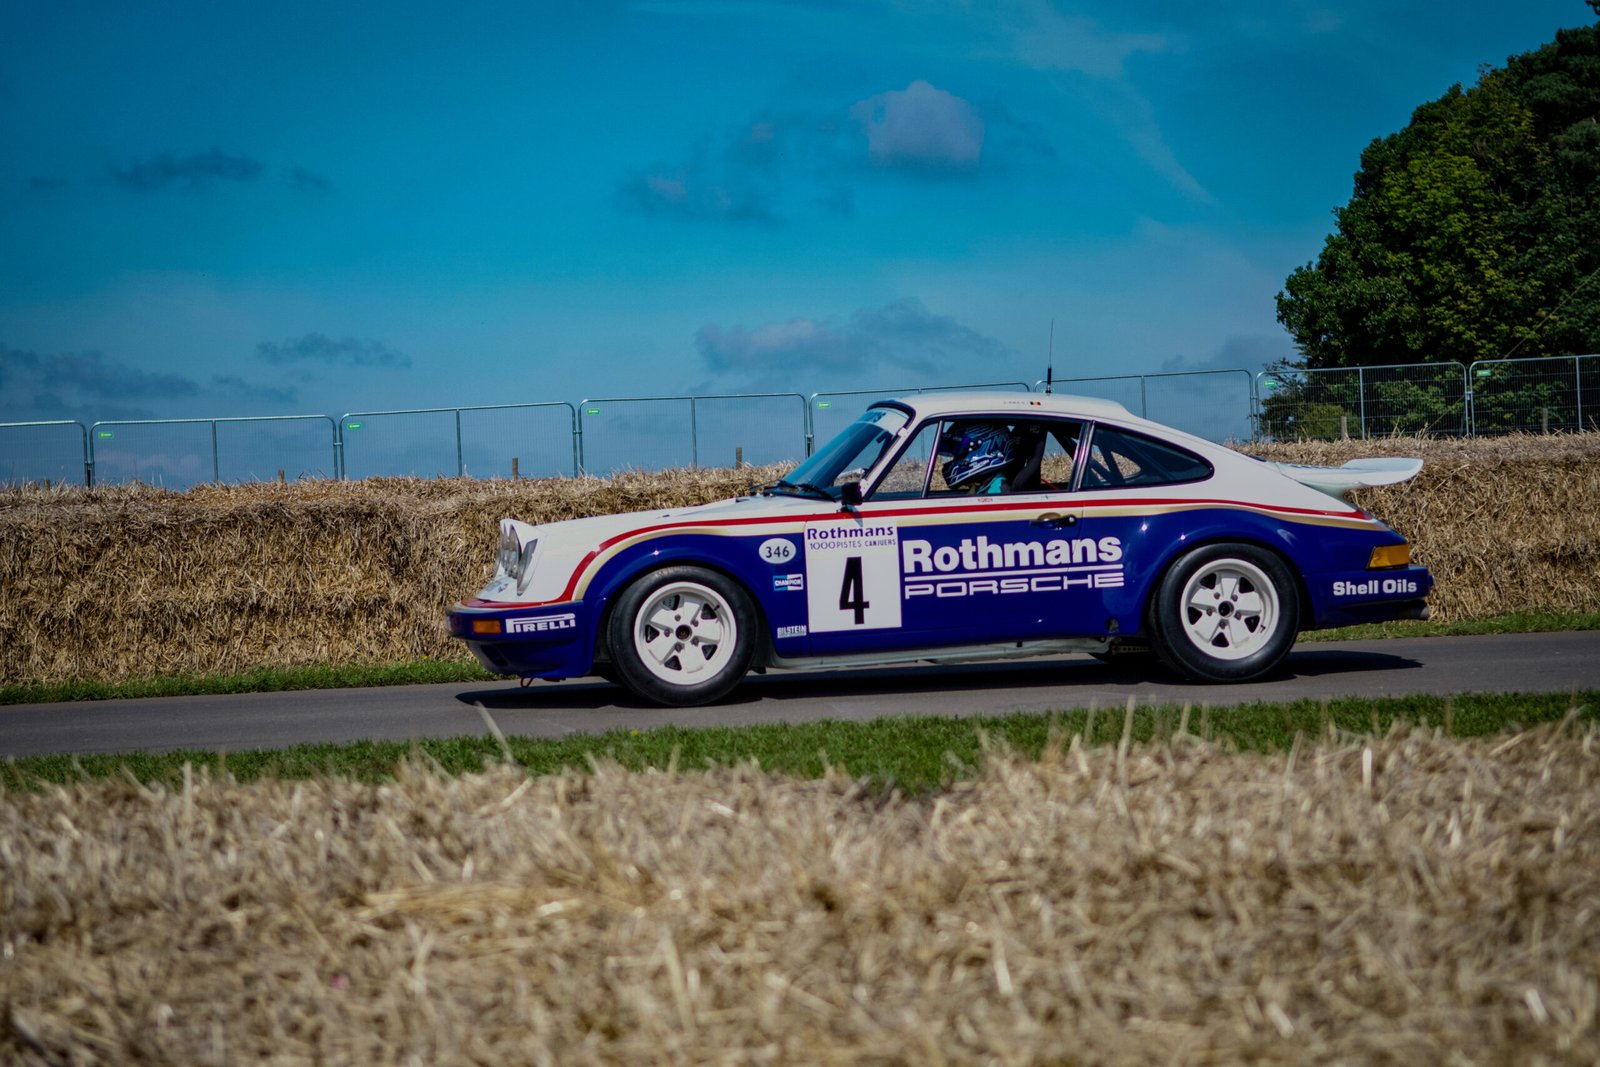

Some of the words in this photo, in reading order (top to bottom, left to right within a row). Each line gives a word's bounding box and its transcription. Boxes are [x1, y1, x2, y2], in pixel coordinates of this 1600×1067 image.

[807, 527, 894, 540] Rothmans
[765, 546, 790, 559] 346
[902, 536, 1123, 573] Rothmans
[774, 578, 802, 587] CHAMPION
[839, 556, 870, 625] 4
[904, 572, 1125, 599] PORSCHE
[1333, 580, 1379, 596] Shell
[1382, 579, 1417, 593] Oils
[505, 613, 576, 633] PIRELLI
[777, 625, 807, 636] BILSTEIN
